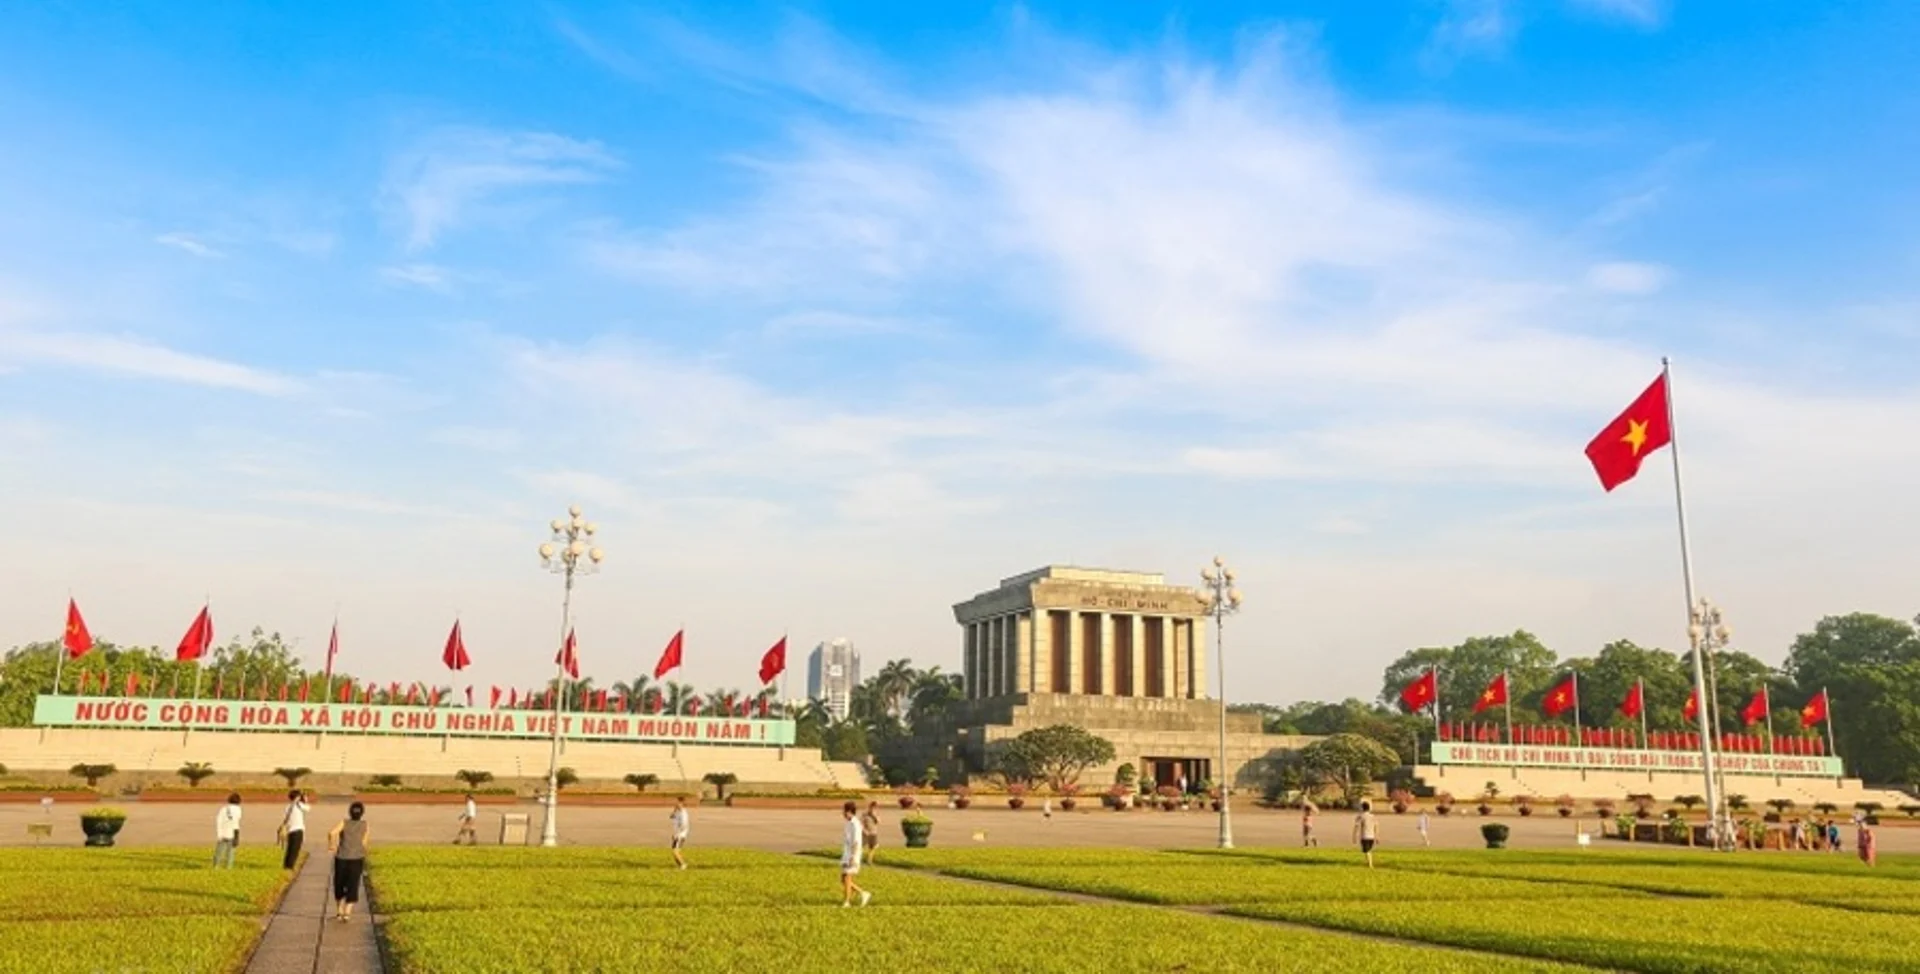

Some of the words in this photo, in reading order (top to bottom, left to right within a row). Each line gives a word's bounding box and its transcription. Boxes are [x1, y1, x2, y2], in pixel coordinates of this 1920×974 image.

[75, 700, 148, 721] NƯỚC
[159, 702, 229, 726] CỘNG
[240, 702, 289, 725] HÒA
[300, 705, 330, 726] XÃ
[341, 707, 381, 731] HỘI
[391, 706, 436, 729] CHỦ
[446, 711, 515, 732] NGHĨA
[526, 713, 572, 736] VIỆT
[582, 717, 629, 735] NAM
[1543, 750, 1570, 763] MINH
